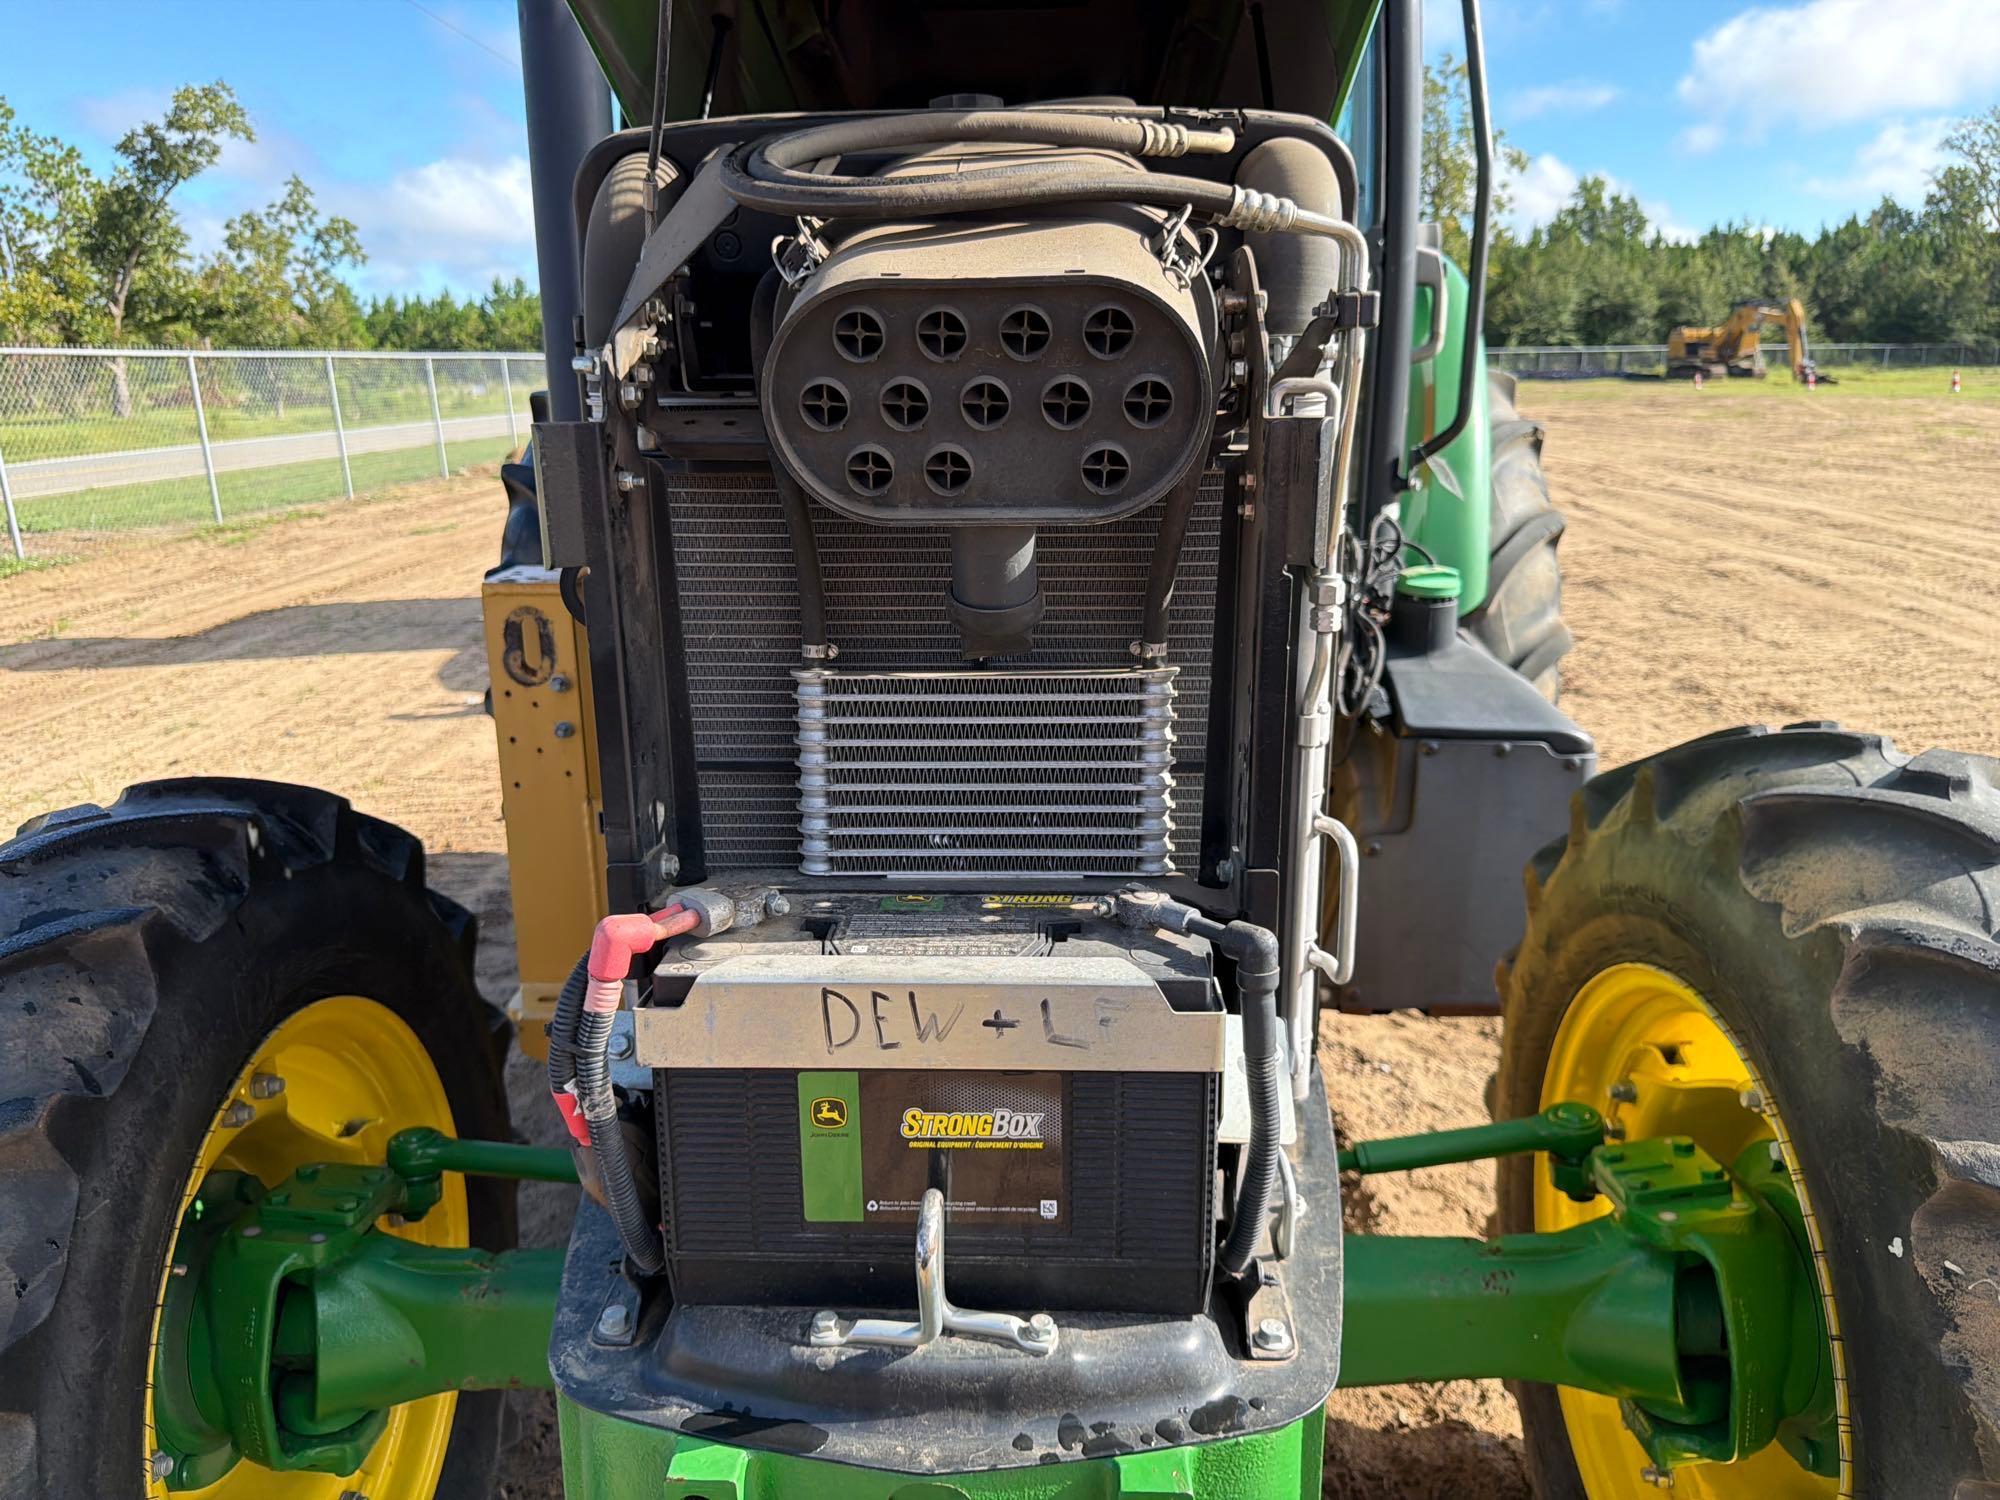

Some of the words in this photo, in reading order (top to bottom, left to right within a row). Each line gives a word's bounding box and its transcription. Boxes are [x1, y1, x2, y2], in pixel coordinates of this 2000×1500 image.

[820, 987, 965, 1054] DEW
[909, 1141, 936, 1149] ORIGINAL
[937, 1141, 971, 1149] EQUIPMENT
[1013, 1141, 1044, 1149] D'ORIGINE
